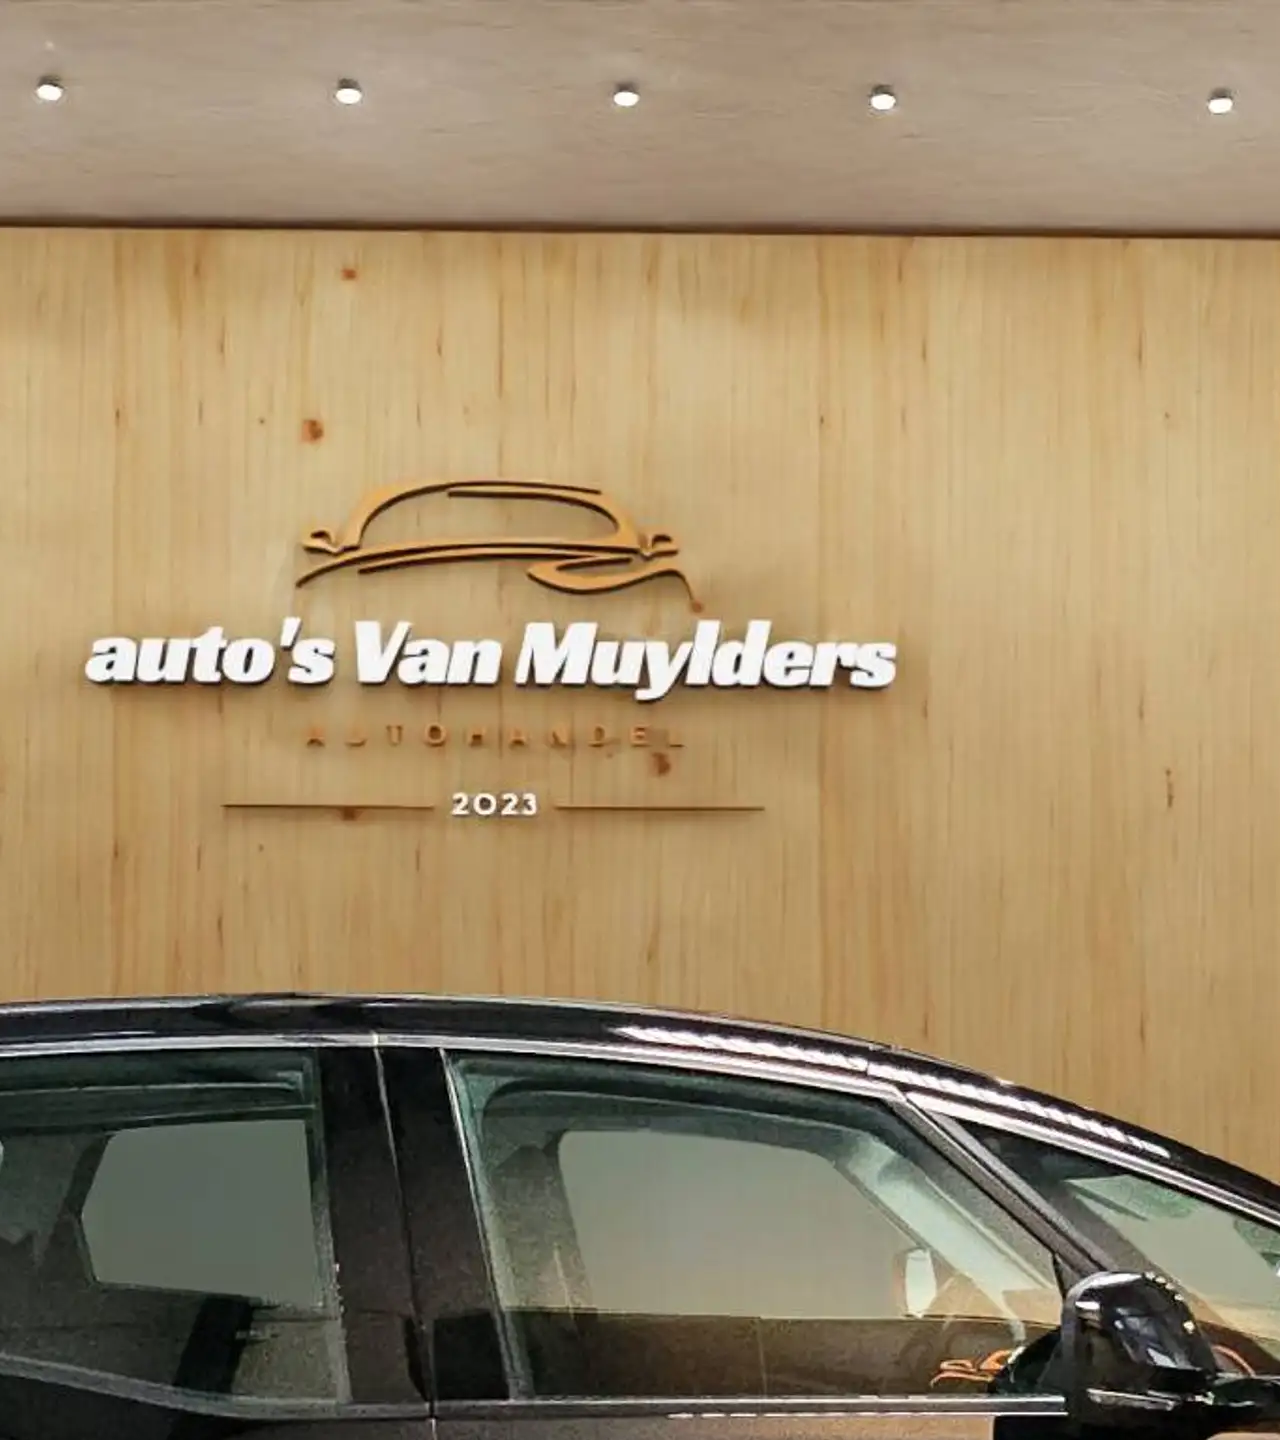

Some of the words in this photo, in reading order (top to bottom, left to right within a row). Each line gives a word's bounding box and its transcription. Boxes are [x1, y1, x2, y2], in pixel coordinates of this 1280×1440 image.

[85, 618, 335, 686] auto's
[354, 620, 502, 687] Van
[514, 619, 898, 702] Muylders
[451, 792, 538, 817] 2023
